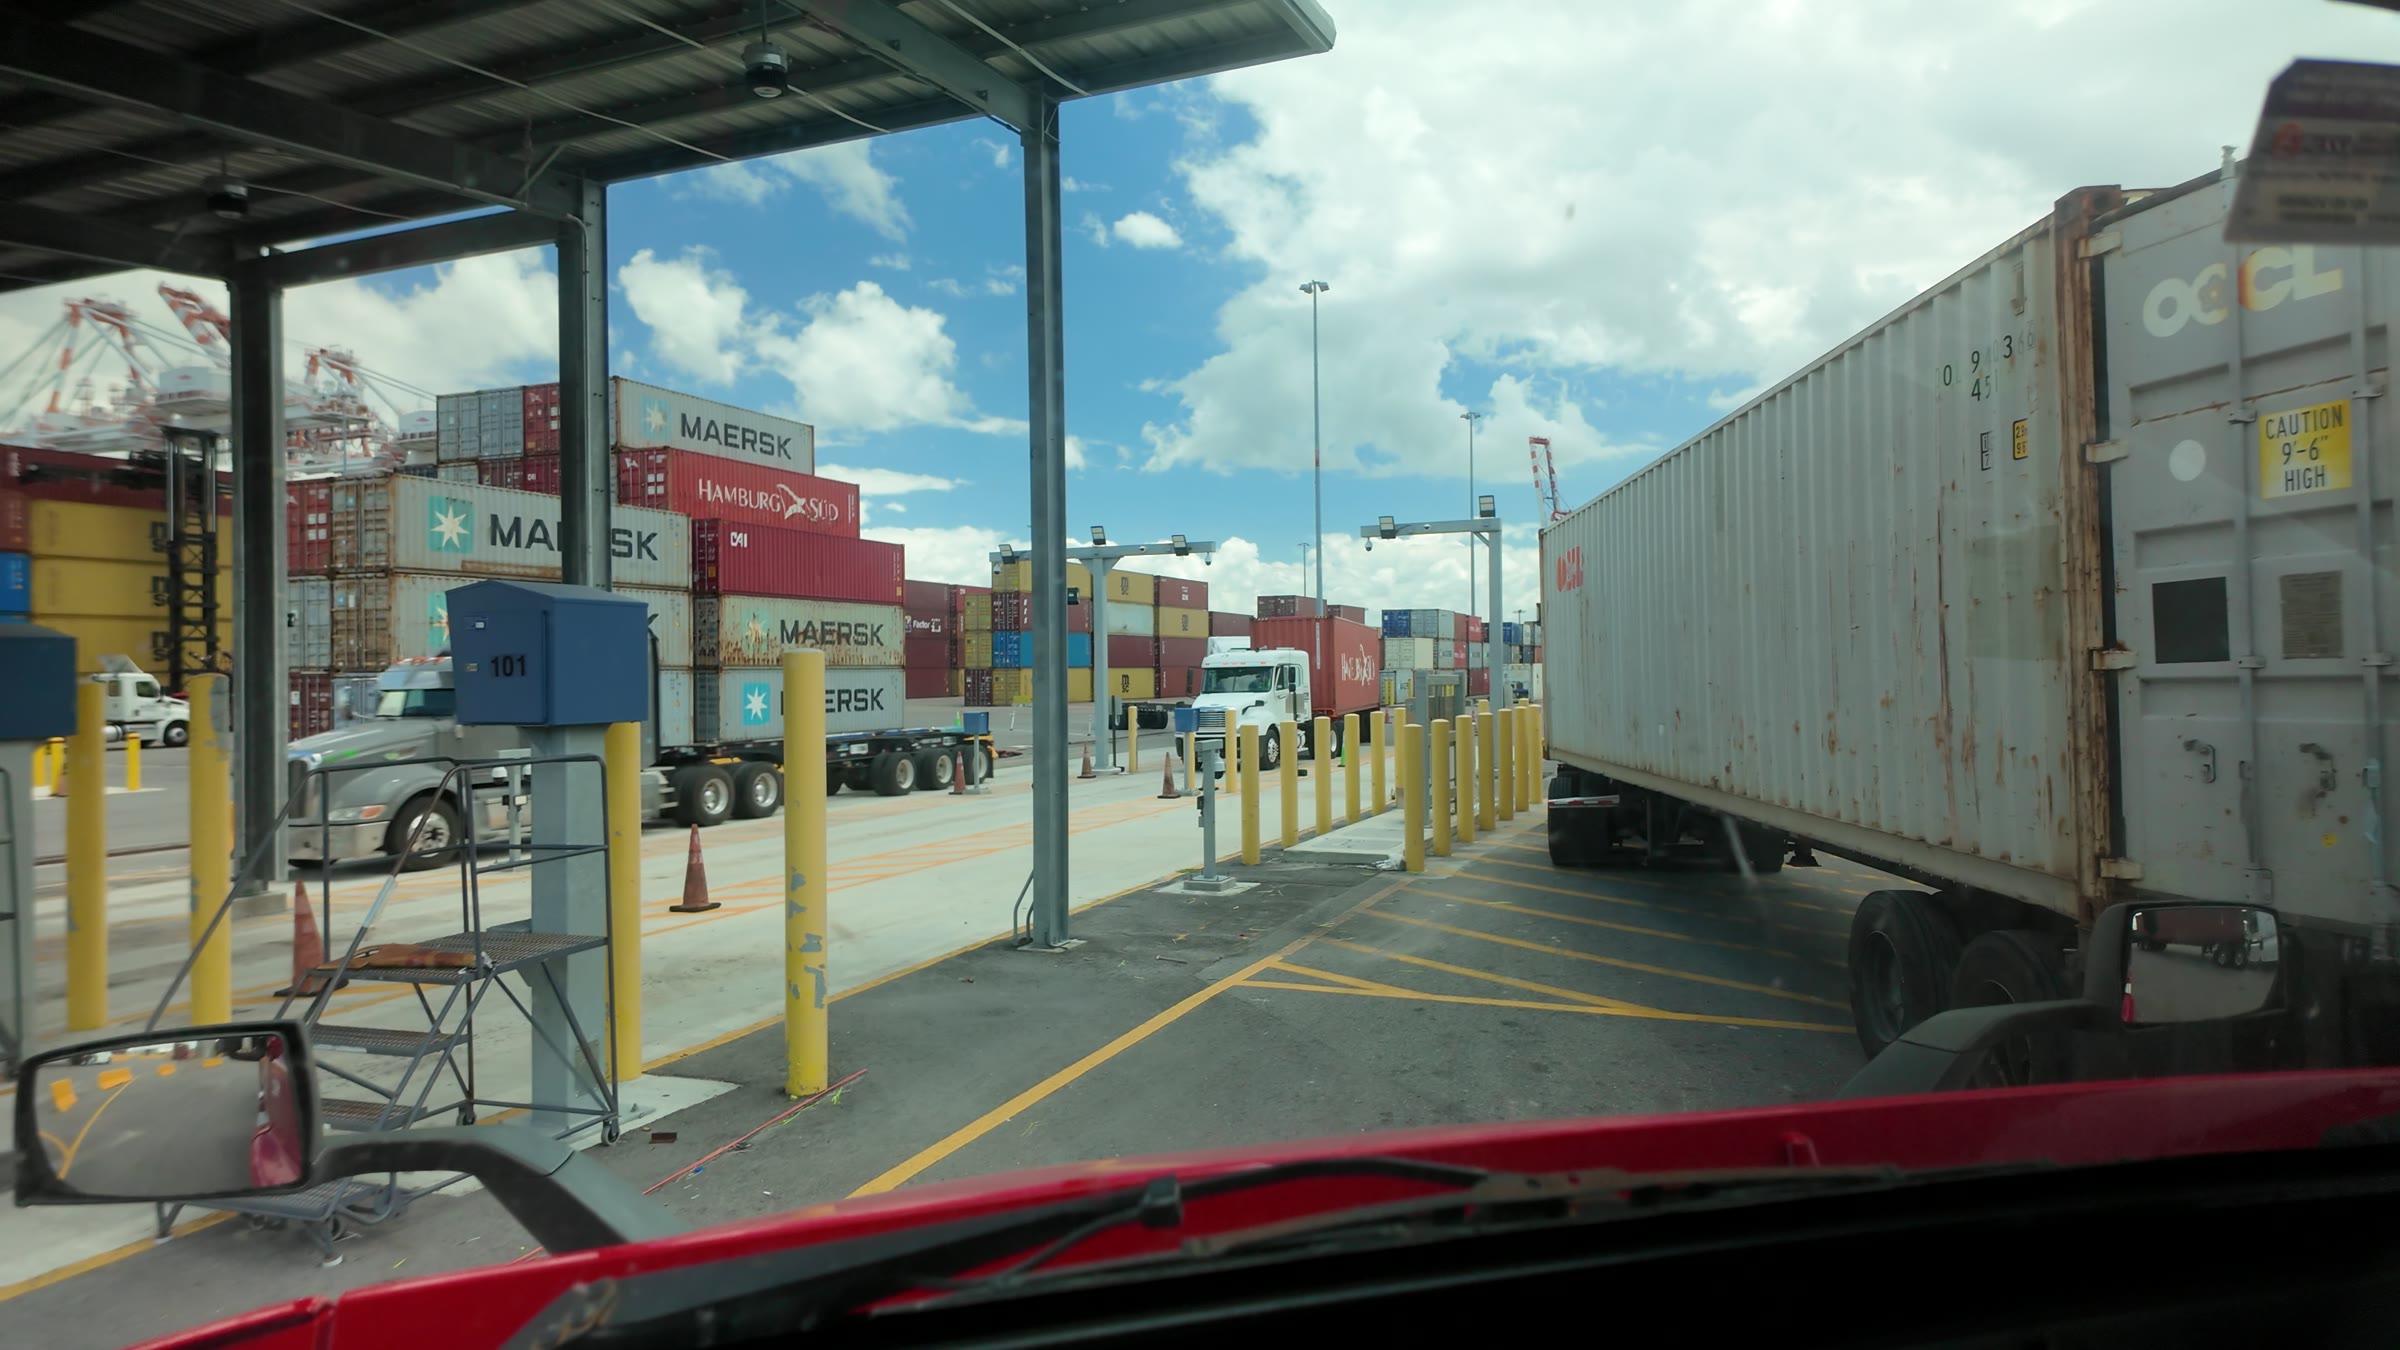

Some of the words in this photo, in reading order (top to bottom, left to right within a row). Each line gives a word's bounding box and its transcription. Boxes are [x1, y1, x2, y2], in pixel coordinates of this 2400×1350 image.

[680, 412, 793, 460] MAERSK
[2265, 404, 2344, 440] CAUTION
[2282, 435, 2329, 466] 9'-6"
[2284, 464, 2326, 493] HIGH
[698, 478, 782, 513] HAMBURG
[490, 513, 658, 562] MASK
[730, 531, 748, 548] CAI
[780, 619, 885, 647] MAERSK
[490, 655, 527, 678] 101
[780, 687, 885, 716] ERSK
